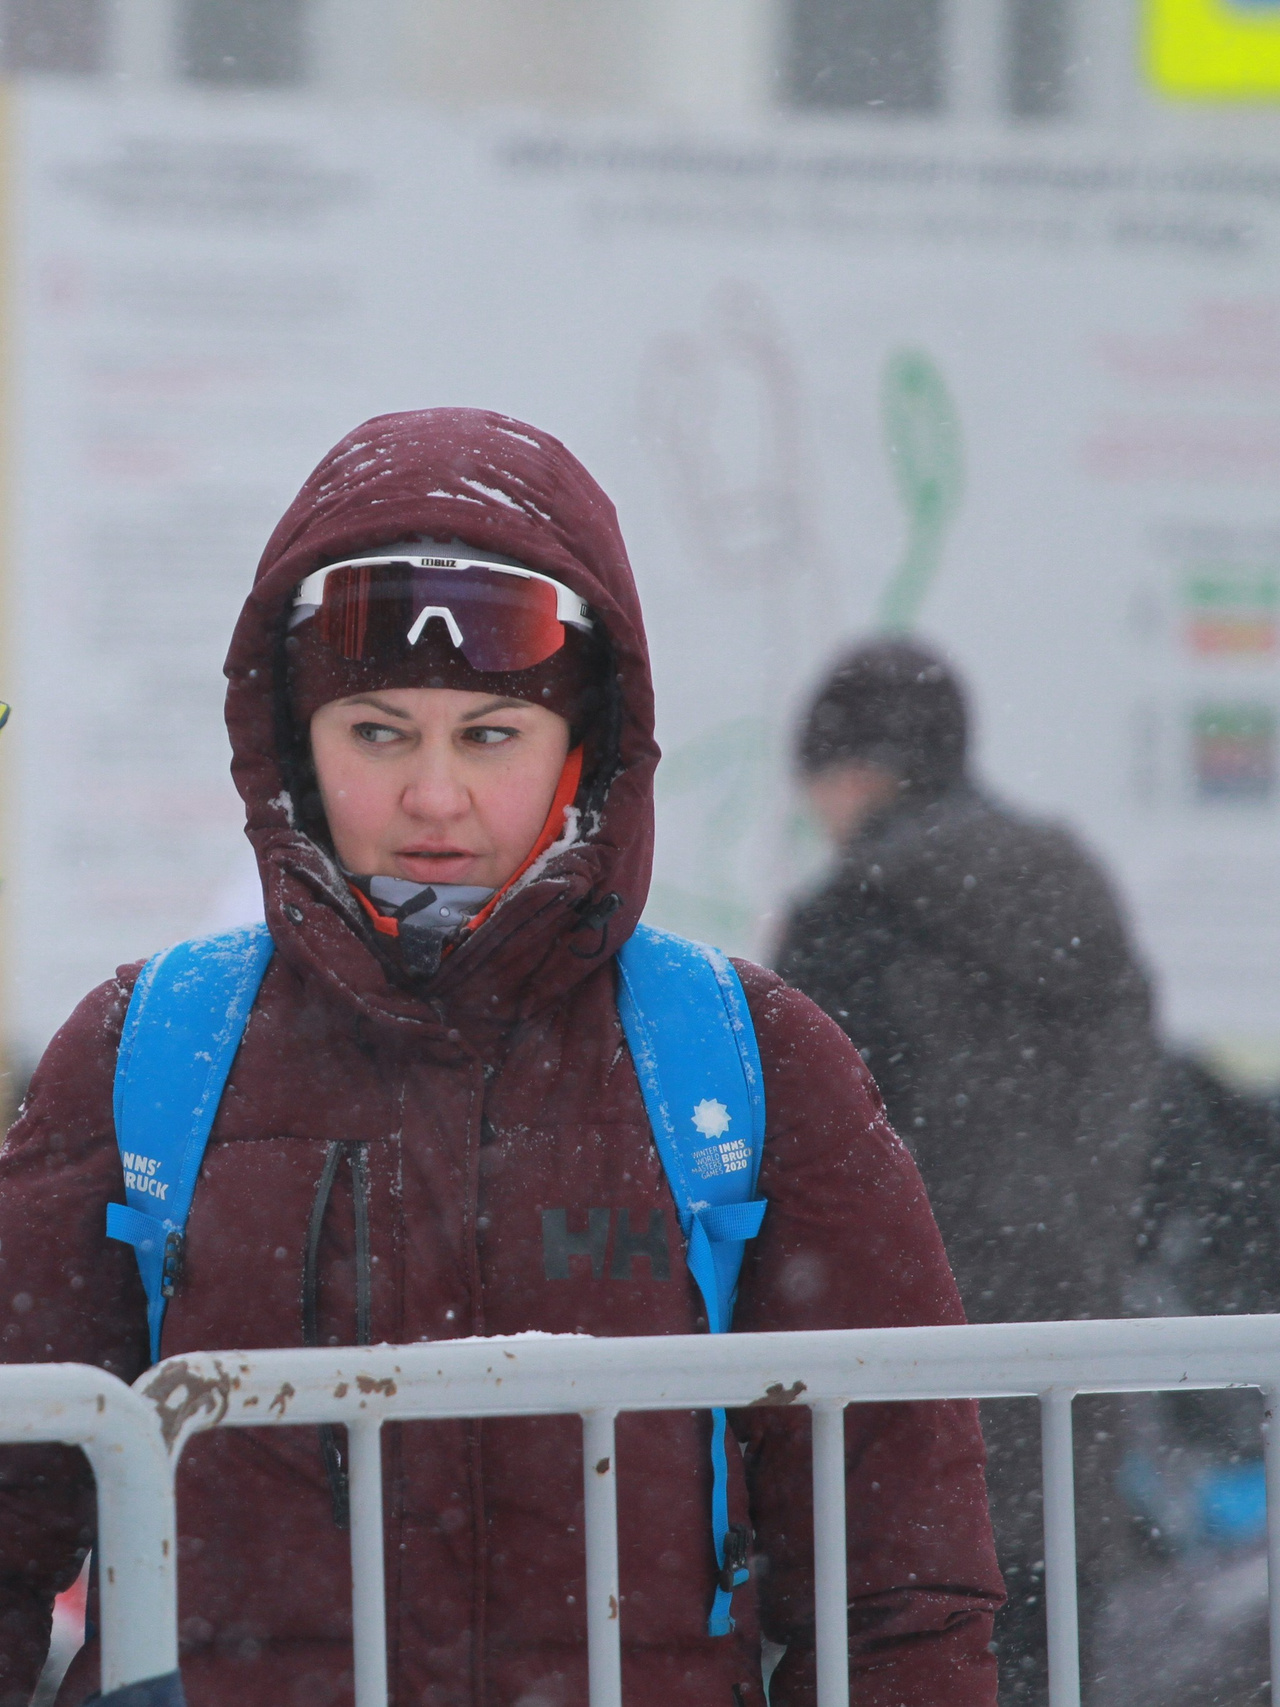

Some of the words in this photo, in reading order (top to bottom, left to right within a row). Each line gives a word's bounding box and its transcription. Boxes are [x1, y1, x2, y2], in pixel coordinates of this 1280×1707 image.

[434, 559, 457, 568] BLIZ
[693, 1146, 717, 1158] WINTER
[696, 1153, 720, 1165] WORLD
[691, 1160, 723, 1173] MASTERS
[724, 1160, 747, 1173] 2020
[701, 1168, 724, 1180] GAMES
[123, 1170, 169, 1200] RUCK
[541, 1208, 671, 1281] HH
